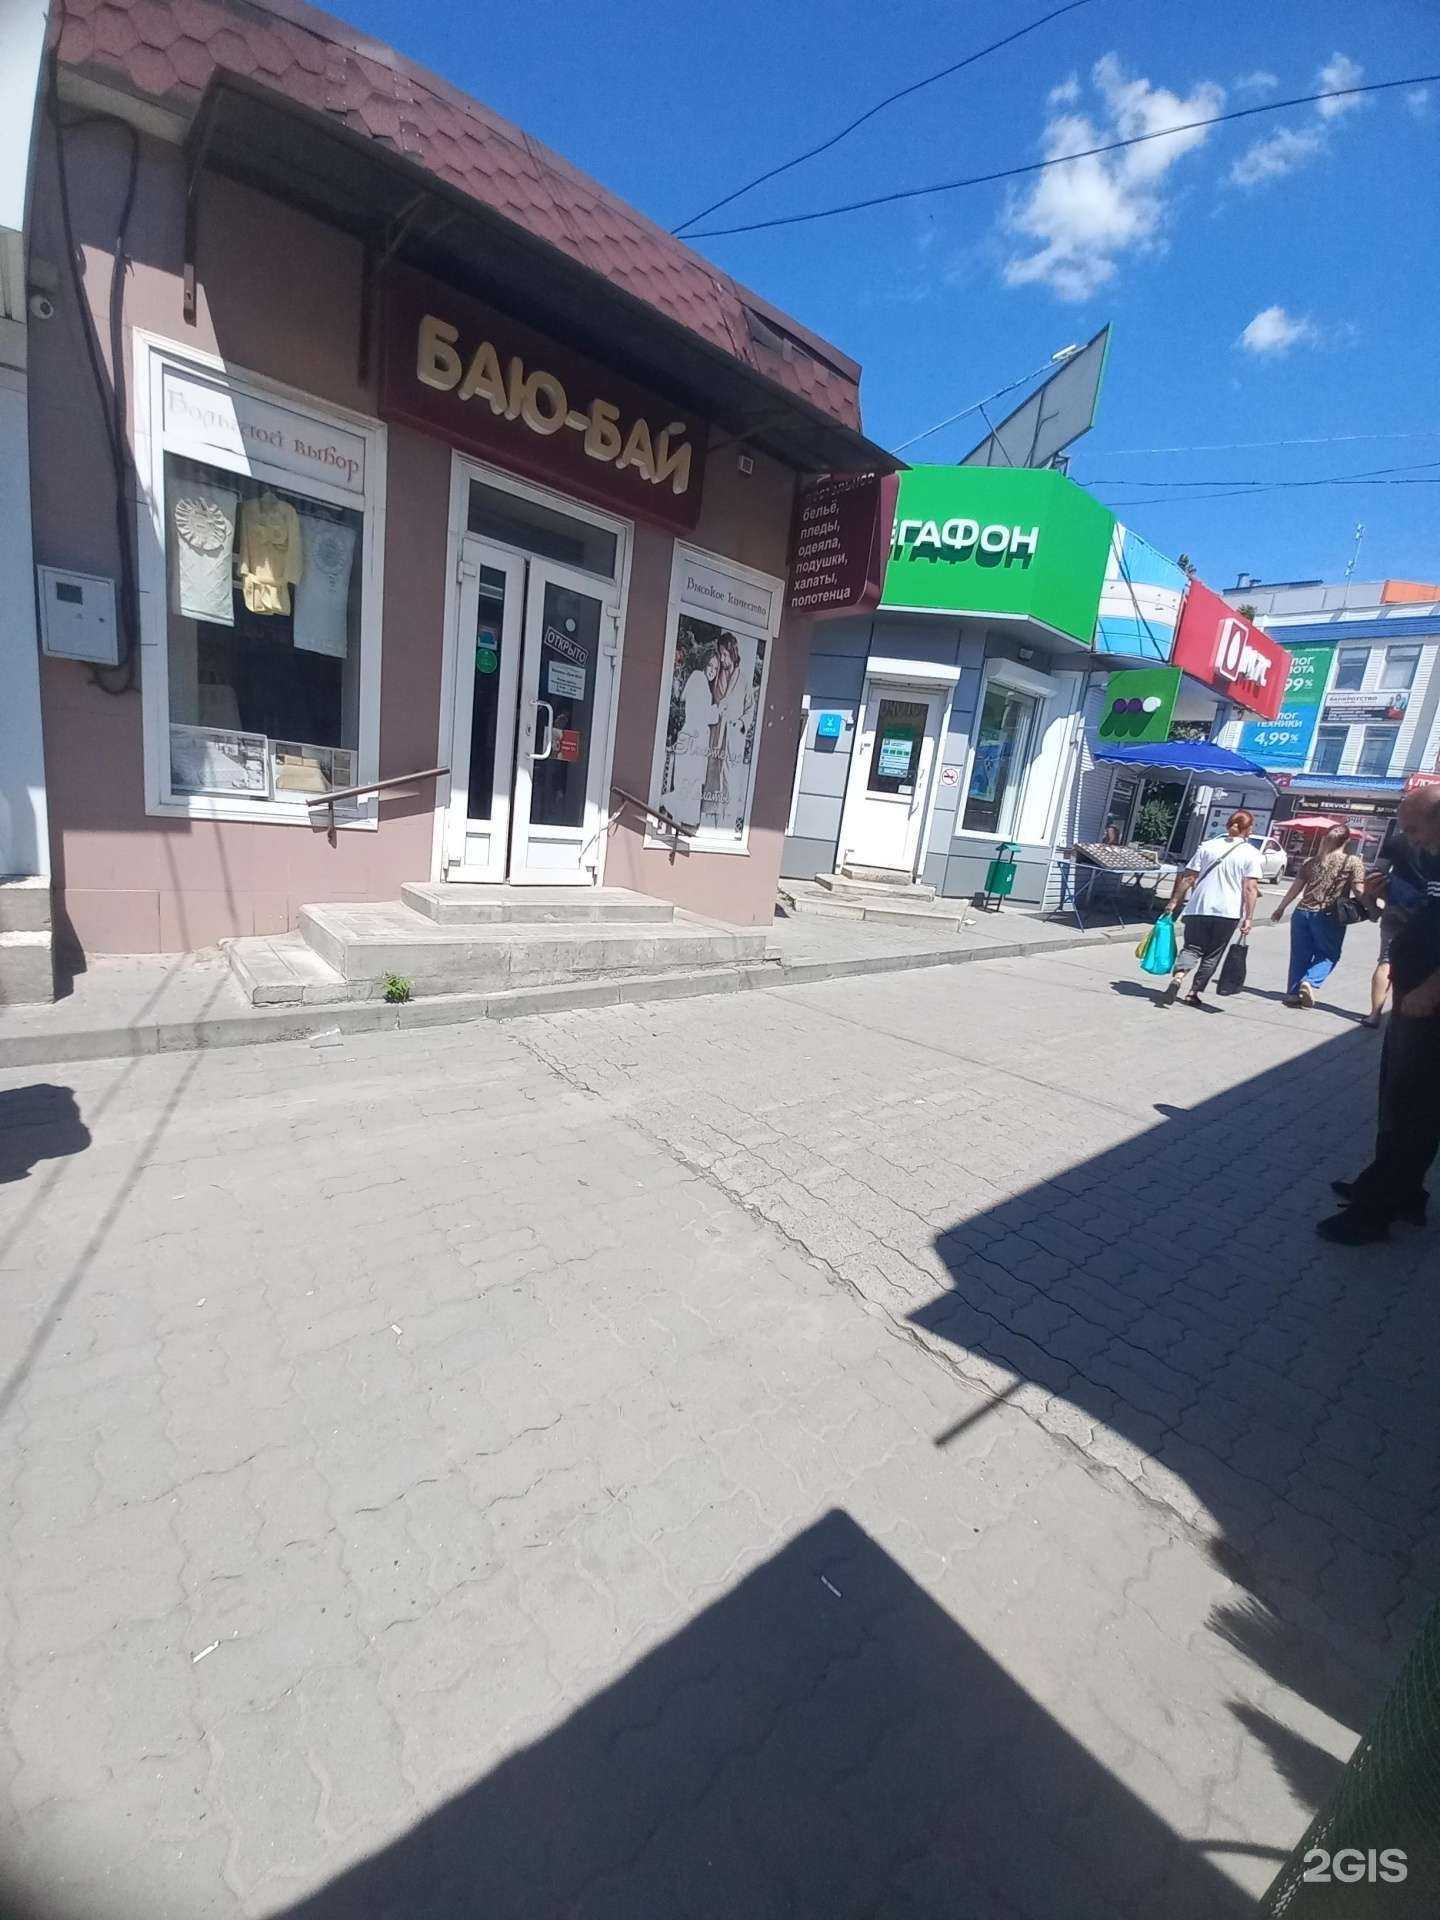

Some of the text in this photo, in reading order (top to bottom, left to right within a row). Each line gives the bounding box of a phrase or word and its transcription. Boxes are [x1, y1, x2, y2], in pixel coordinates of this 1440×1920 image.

[416, 313, 692, 495] БАЮ-БАЙ
[294, 439, 360, 481] выбор
[800, 519, 841, 540] пледы,
[798, 536, 841, 558] одеяла,
[795, 552, 849, 574] подушки,
[793, 572, 838, 591] халаты,
[791, 586, 852, 608] полотенца
[547, 632, 587, 664] ОТКРЫТО
